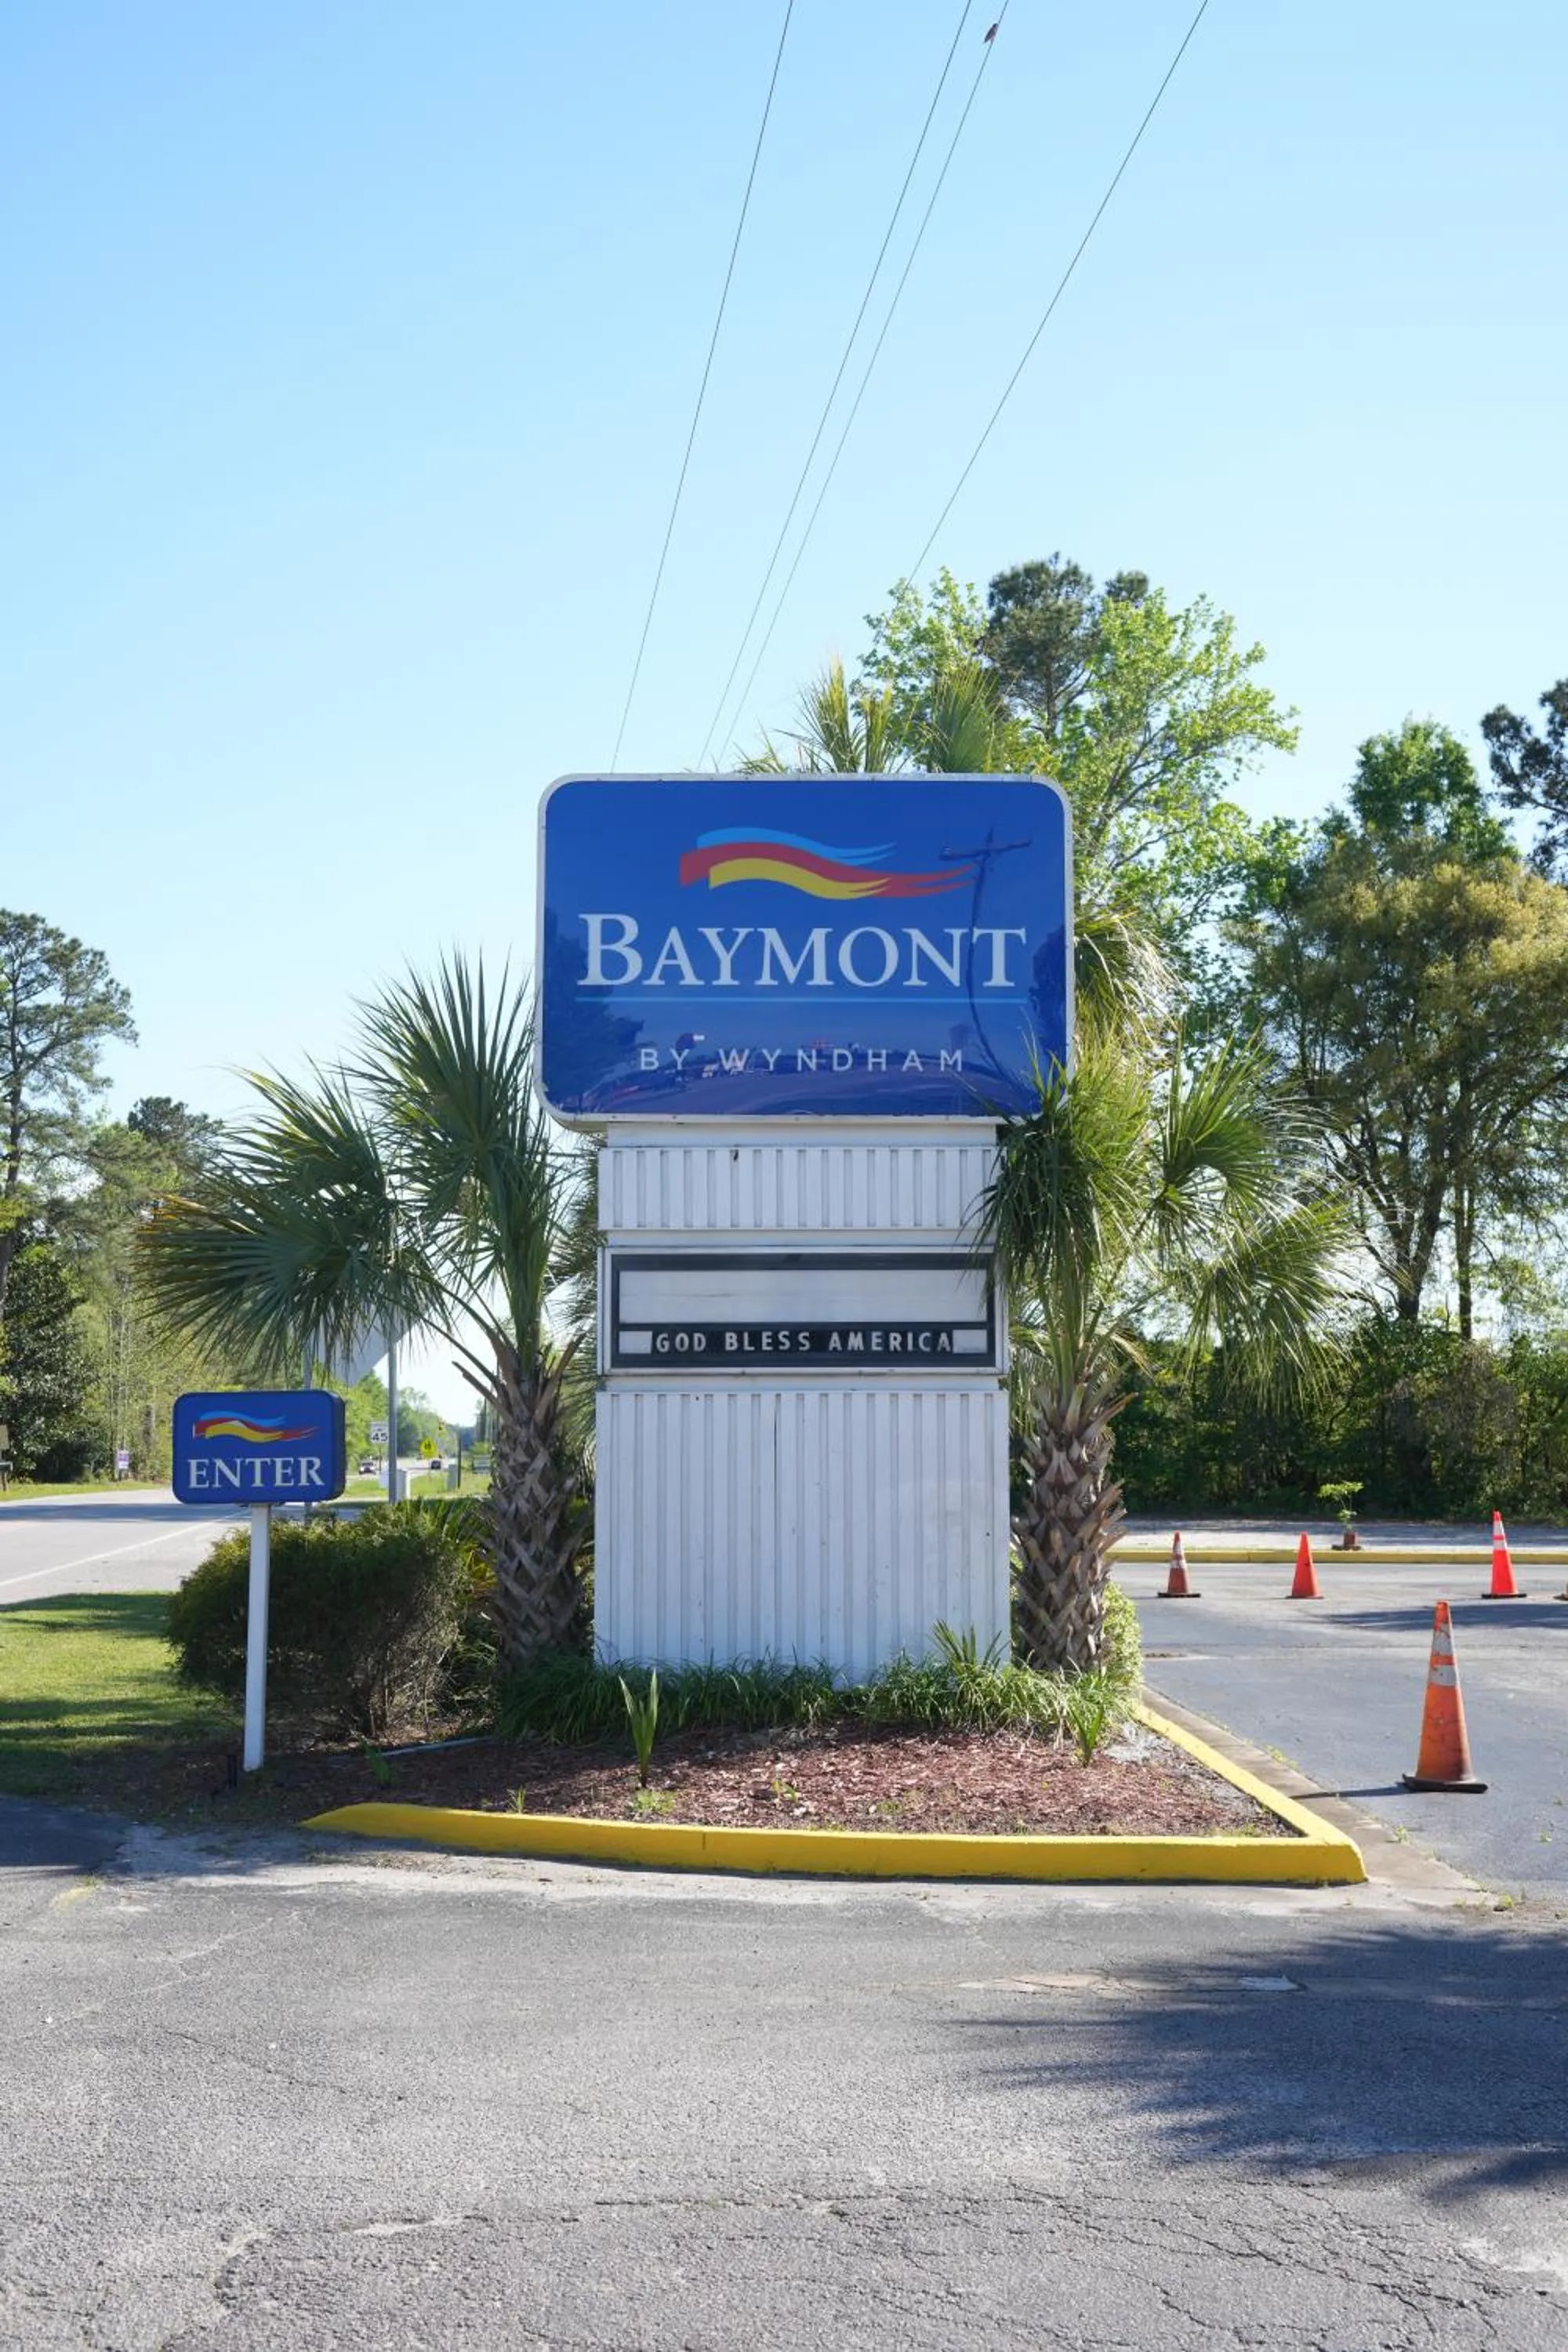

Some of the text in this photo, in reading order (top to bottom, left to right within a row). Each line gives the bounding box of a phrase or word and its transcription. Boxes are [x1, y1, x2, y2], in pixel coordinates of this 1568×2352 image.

[576, 913, 1026, 989] BAYMONT
[640, 1047, 963, 1071] BY WYNDHAM
[655, 1330, 954, 1352] GOD BLESS AMERICA
[372, 1432, 388, 1441] 45
[188, 1457, 325, 1488] ENTER
